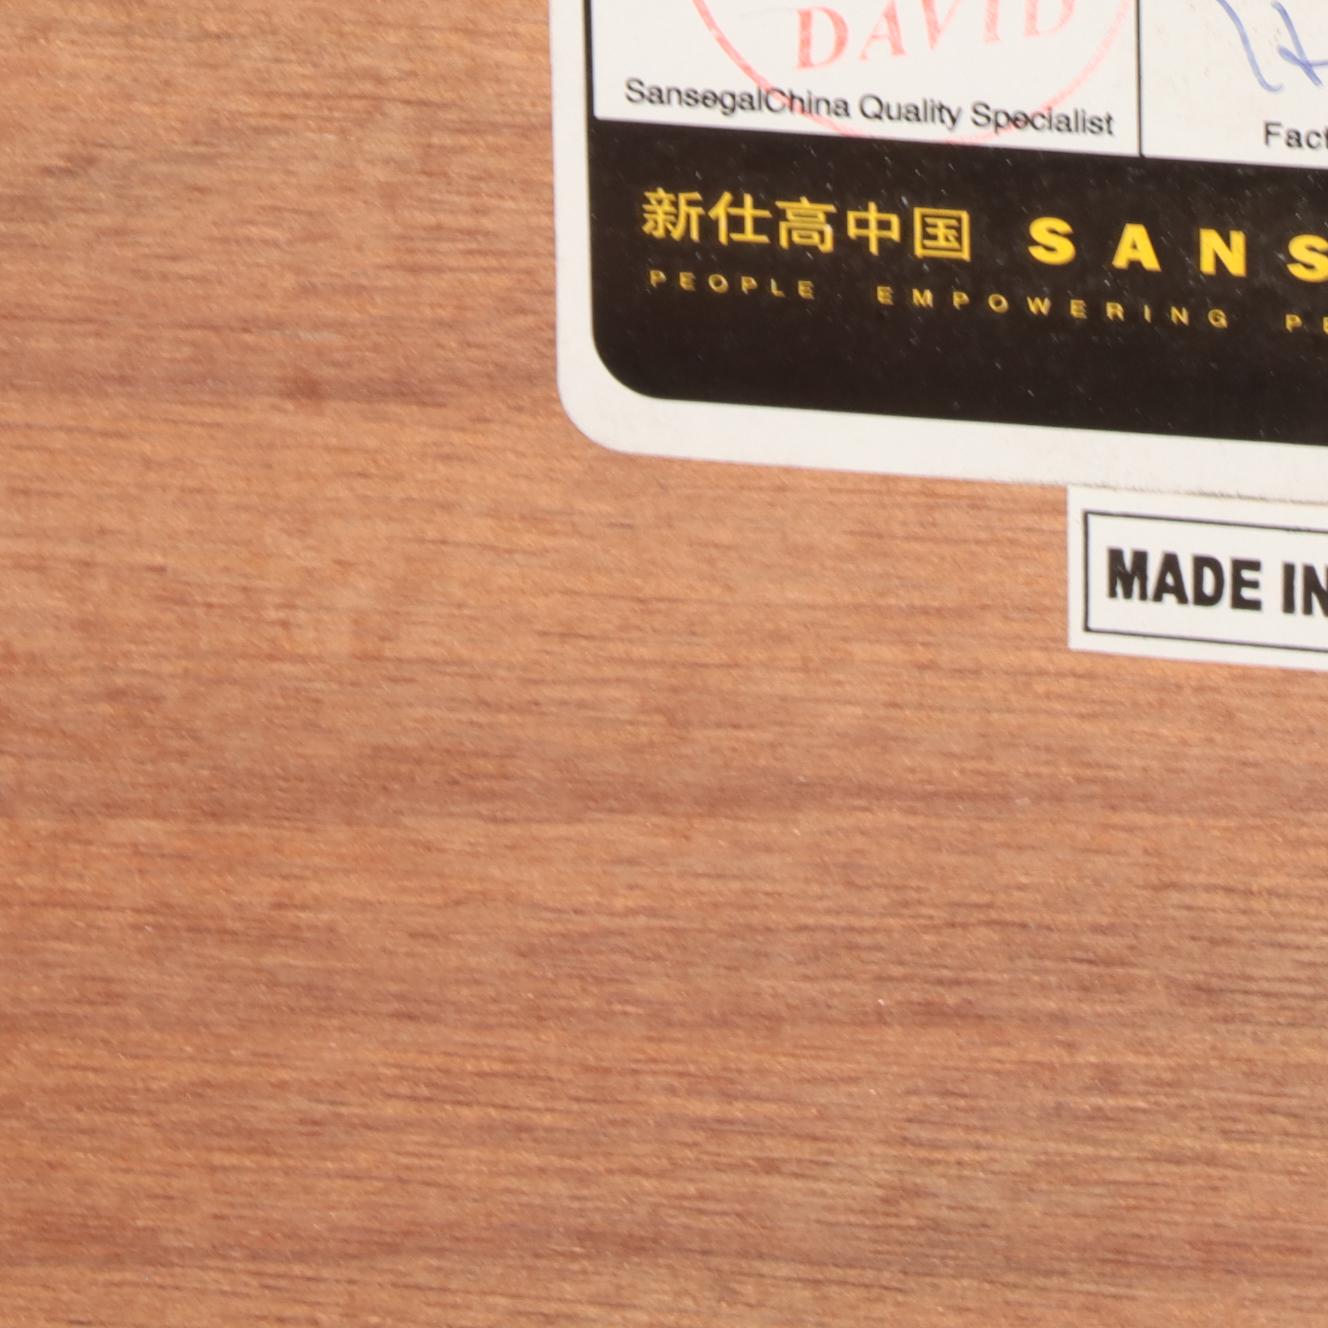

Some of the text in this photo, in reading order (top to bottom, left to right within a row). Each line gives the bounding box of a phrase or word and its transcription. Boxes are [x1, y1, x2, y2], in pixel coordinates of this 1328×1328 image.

[625, 77, 1115, 136] SansegalChina Quality Specialist
[641, 187, 971, 261] 新仕高中国
[650, 270, 814, 300] PEOPLE
[876, 285, 1229, 329] EMPOWERING
[1107, 547, 1262, 611] MADE
